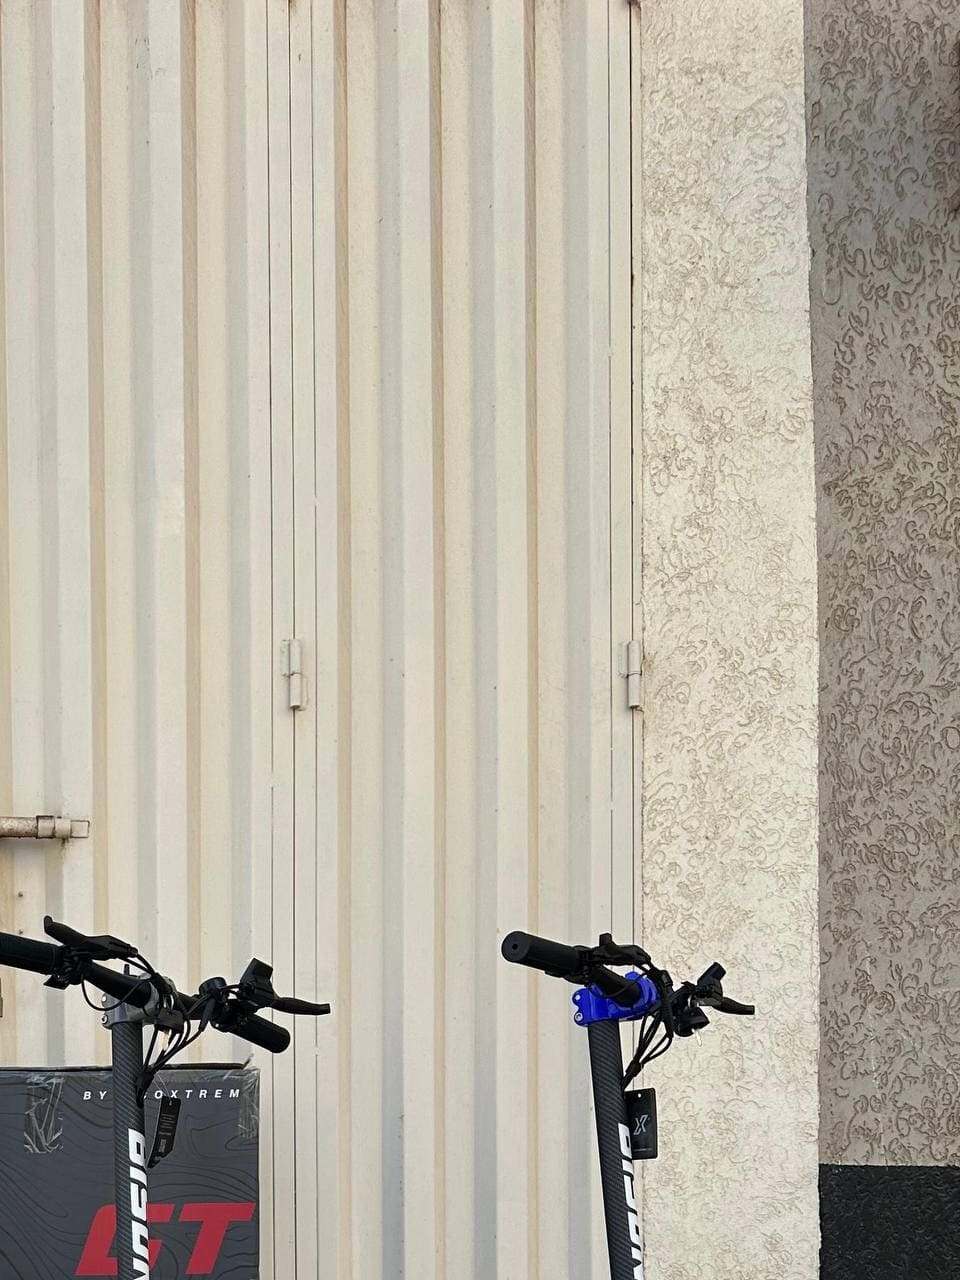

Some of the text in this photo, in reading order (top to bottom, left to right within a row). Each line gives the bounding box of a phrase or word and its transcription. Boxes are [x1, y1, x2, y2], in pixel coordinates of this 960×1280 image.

[83, 1088, 240, 1100] BY OXTREM
[75, 1202, 255, 1276] GT
